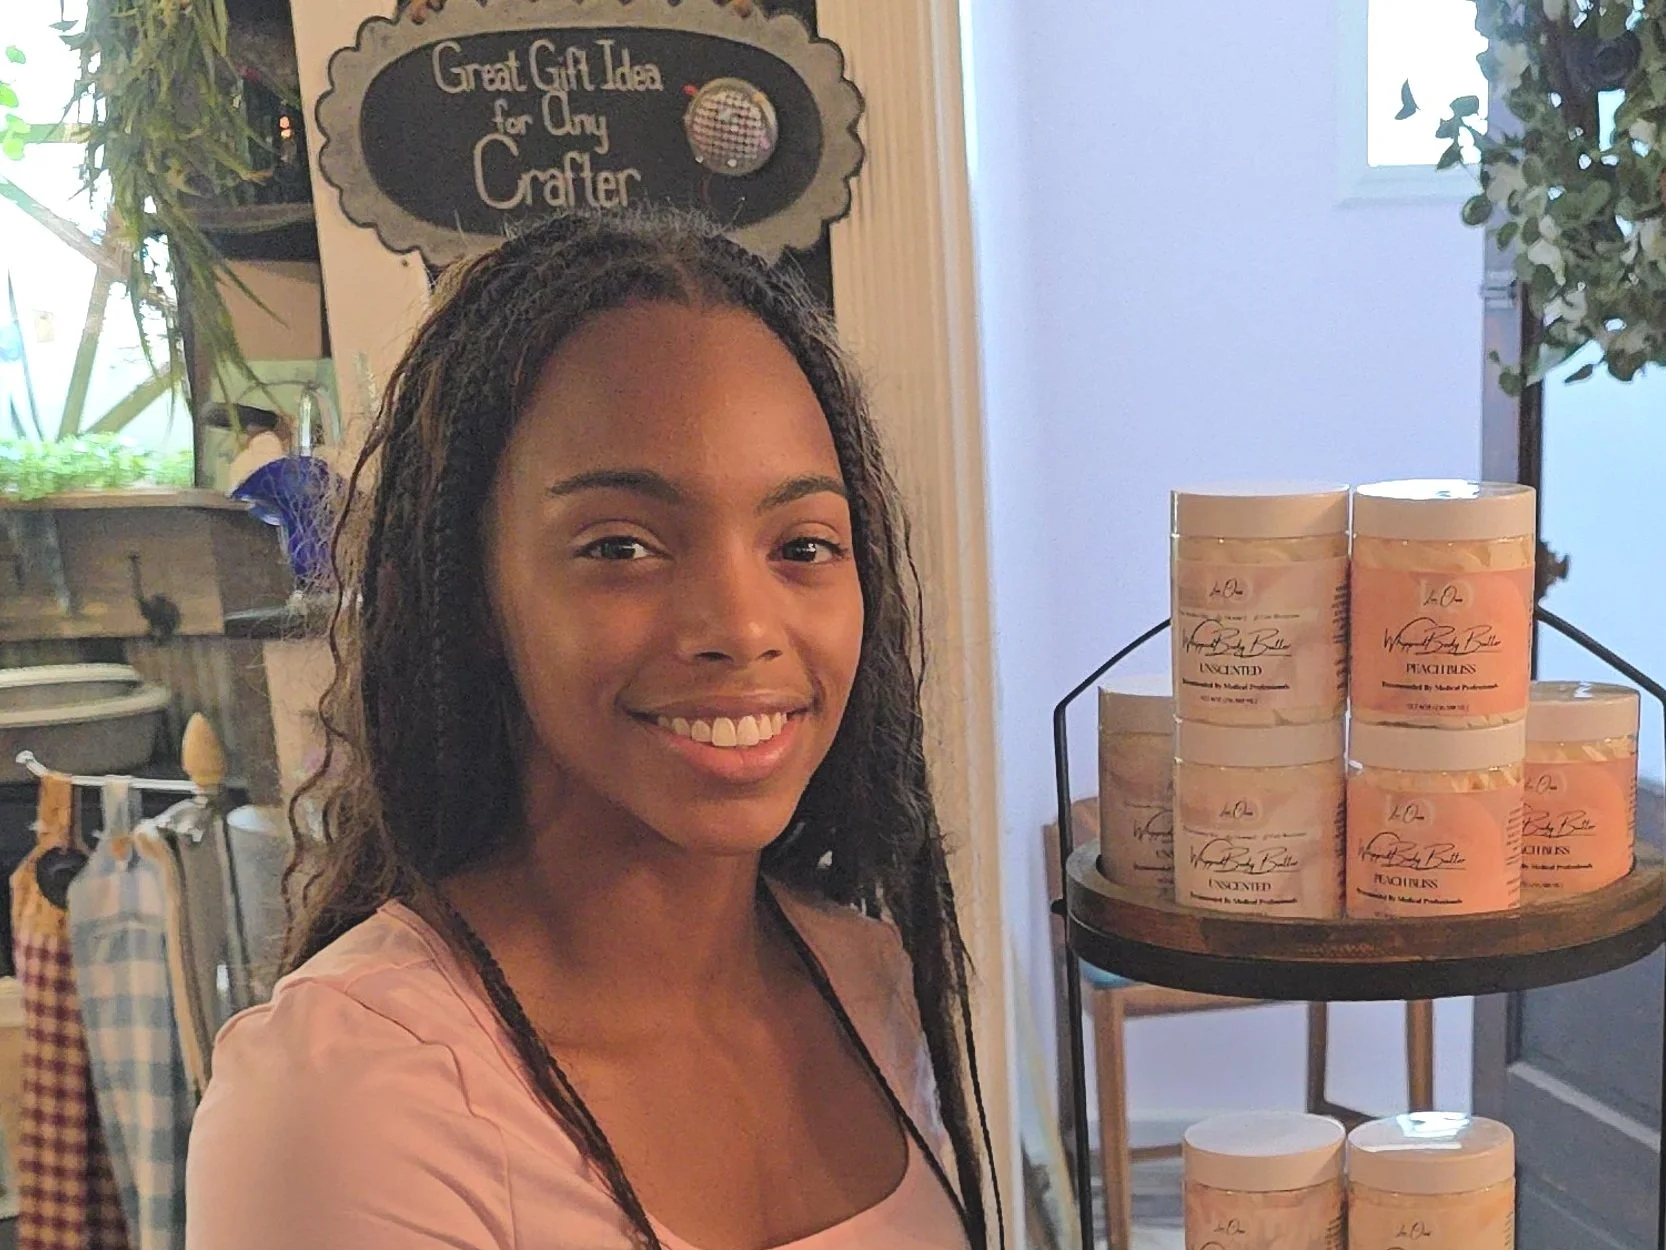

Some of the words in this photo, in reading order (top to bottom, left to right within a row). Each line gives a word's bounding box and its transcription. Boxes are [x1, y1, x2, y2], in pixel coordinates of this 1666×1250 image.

[431, 40, 526, 95] Great
[530, 38, 594, 93] Gift
[597, 39, 663, 93] Idea
[493, 99, 532, 136] for
[542, 94, 609, 153] Any
[473, 132, 641, 209] Crafter
[1200, 663, 1262, 676] UNSCENTED
